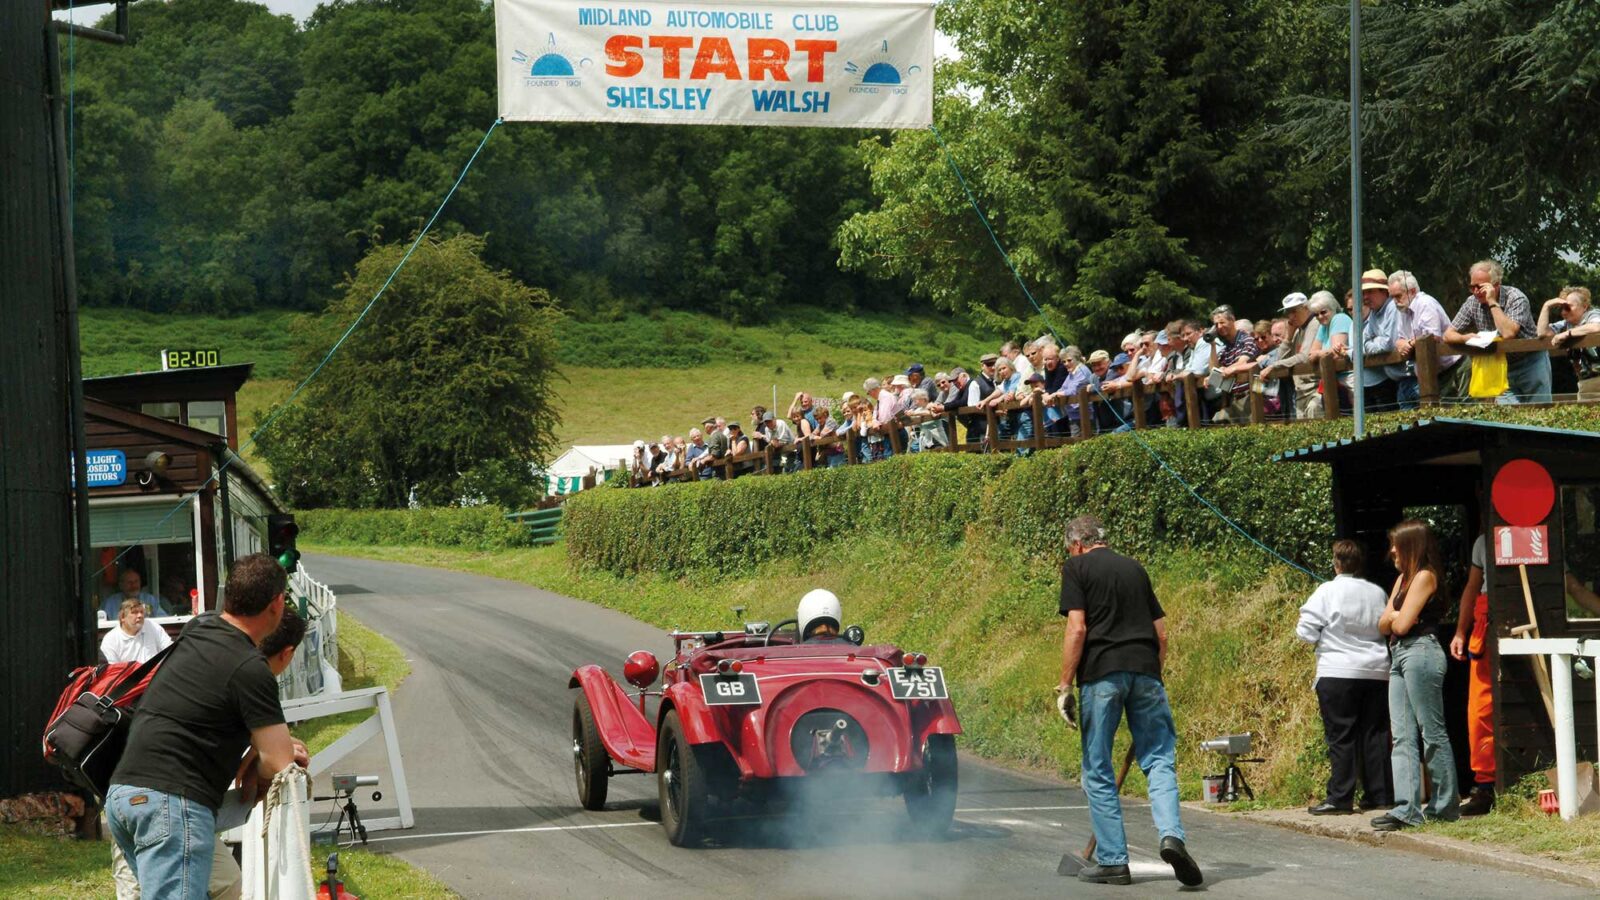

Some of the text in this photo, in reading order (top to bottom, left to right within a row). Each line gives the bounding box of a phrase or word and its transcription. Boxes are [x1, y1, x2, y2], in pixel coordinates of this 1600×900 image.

[579, 8, 839, 31] MIDLAND AUTOMOBILE CLUB
[604, 34, 837, 82] START
[849, 86, 908, 95] FOUNDED 1901
[606, 86, 830, 113] SHELSLEY WALSH
[169, 351, 217, 367] 82.00
[93, 455, 117, 464] LIGHT
[110, 463, 122, 472] TO
[1497, 557, 1548, 565] Fire extinguisher
[893, 669, 937, 683] EAS
[716, 681, 745, 696] GB
[901, 682, 937, 697] 751
